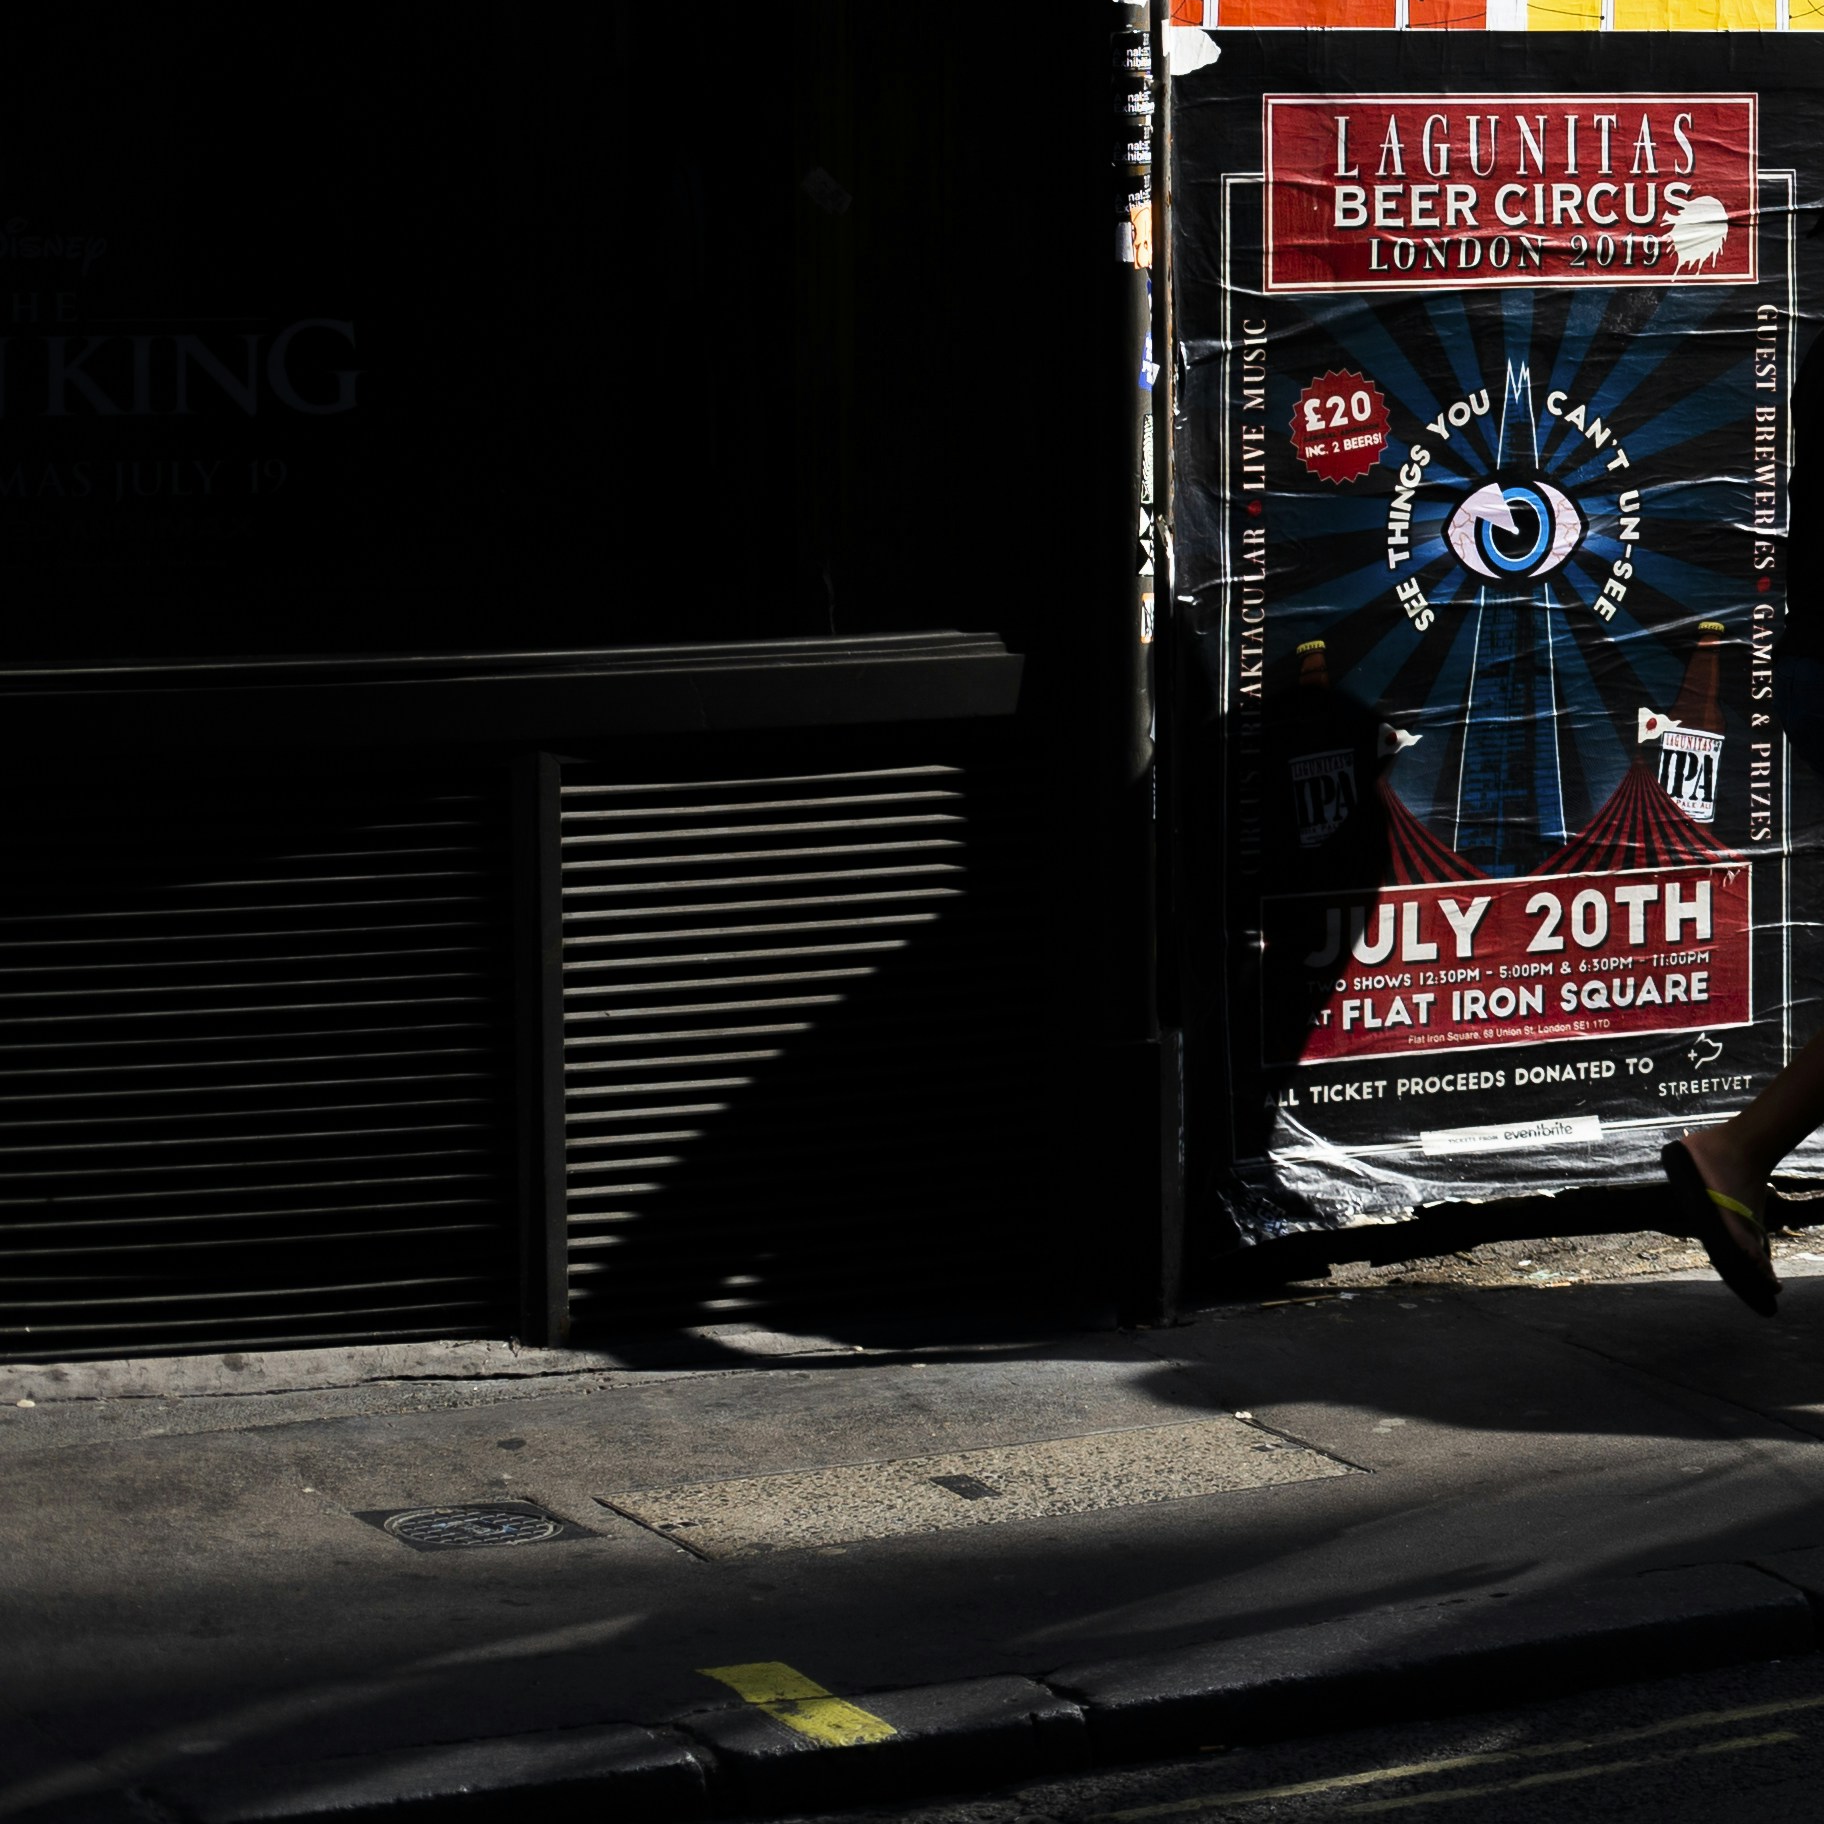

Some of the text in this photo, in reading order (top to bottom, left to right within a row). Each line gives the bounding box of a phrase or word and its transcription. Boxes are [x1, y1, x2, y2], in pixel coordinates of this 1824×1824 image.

[1334, 112, 1696, 177] LAGUNITAS
[1334, 181, 1694, 229] BEER CIRCUS
[1368, 232, 1662, 272] LONDON 2019
[36, 315, 370, 418] KING
[1754, 303, 1780, 392] GUEST
[1242, 318, 1269, 492] LIVE MUSIC
[1303, 390, 1372, 432] £20
[1305, 443, 1329, 459] INC.
[1331, 440, 1341, 454] 2
[1343, 432, 1383, 451] BEERS!
[1387, 387, 1642, 632] SEE THINGS YOU CAN'T UN-SEE
[1754, 405, 1777, 572] BREWERIES
[1751, 603, 1775, 701] GAMES
[1659, 748, 1714, 803] IPA
[1750, 742, 1772, 843] PRIZES
[1302, 880, 1712, 969] JULY 20TH
[1353, 972, 1412, 993] SHOWS
[1419, 967, 1481, 986] 12:30PM
[1499, 962, 1554, 980] 5:00PM
[1578, 956, 1634, 973] 6:30PM
[1652, 950, 1711, 969] 11:00PM
[1308, 971, 1711, 1032] AT FLAT IRON SQUARE
[1408, 1034, 1425, 1045] Flat
[1426, 1033, 1445, 1044] Iron
[1496, 1027, 1522, 1038] Union
[1537, 1022, 1572, 1035] London
[1573, 1020, 1590, 1031] SE1
[1309, 1080, 1386, 1106] TICKET
[1397, 1069, 1506, 1100] PROCEEDS
[1514, 1059, 1616, 1086] DONATED
[1625, 1056, 1654, 1076] TO
[1658, 1073, 1753, 1099] STREETVET
[1503, 1121, 1574, 1142] eventbrite
